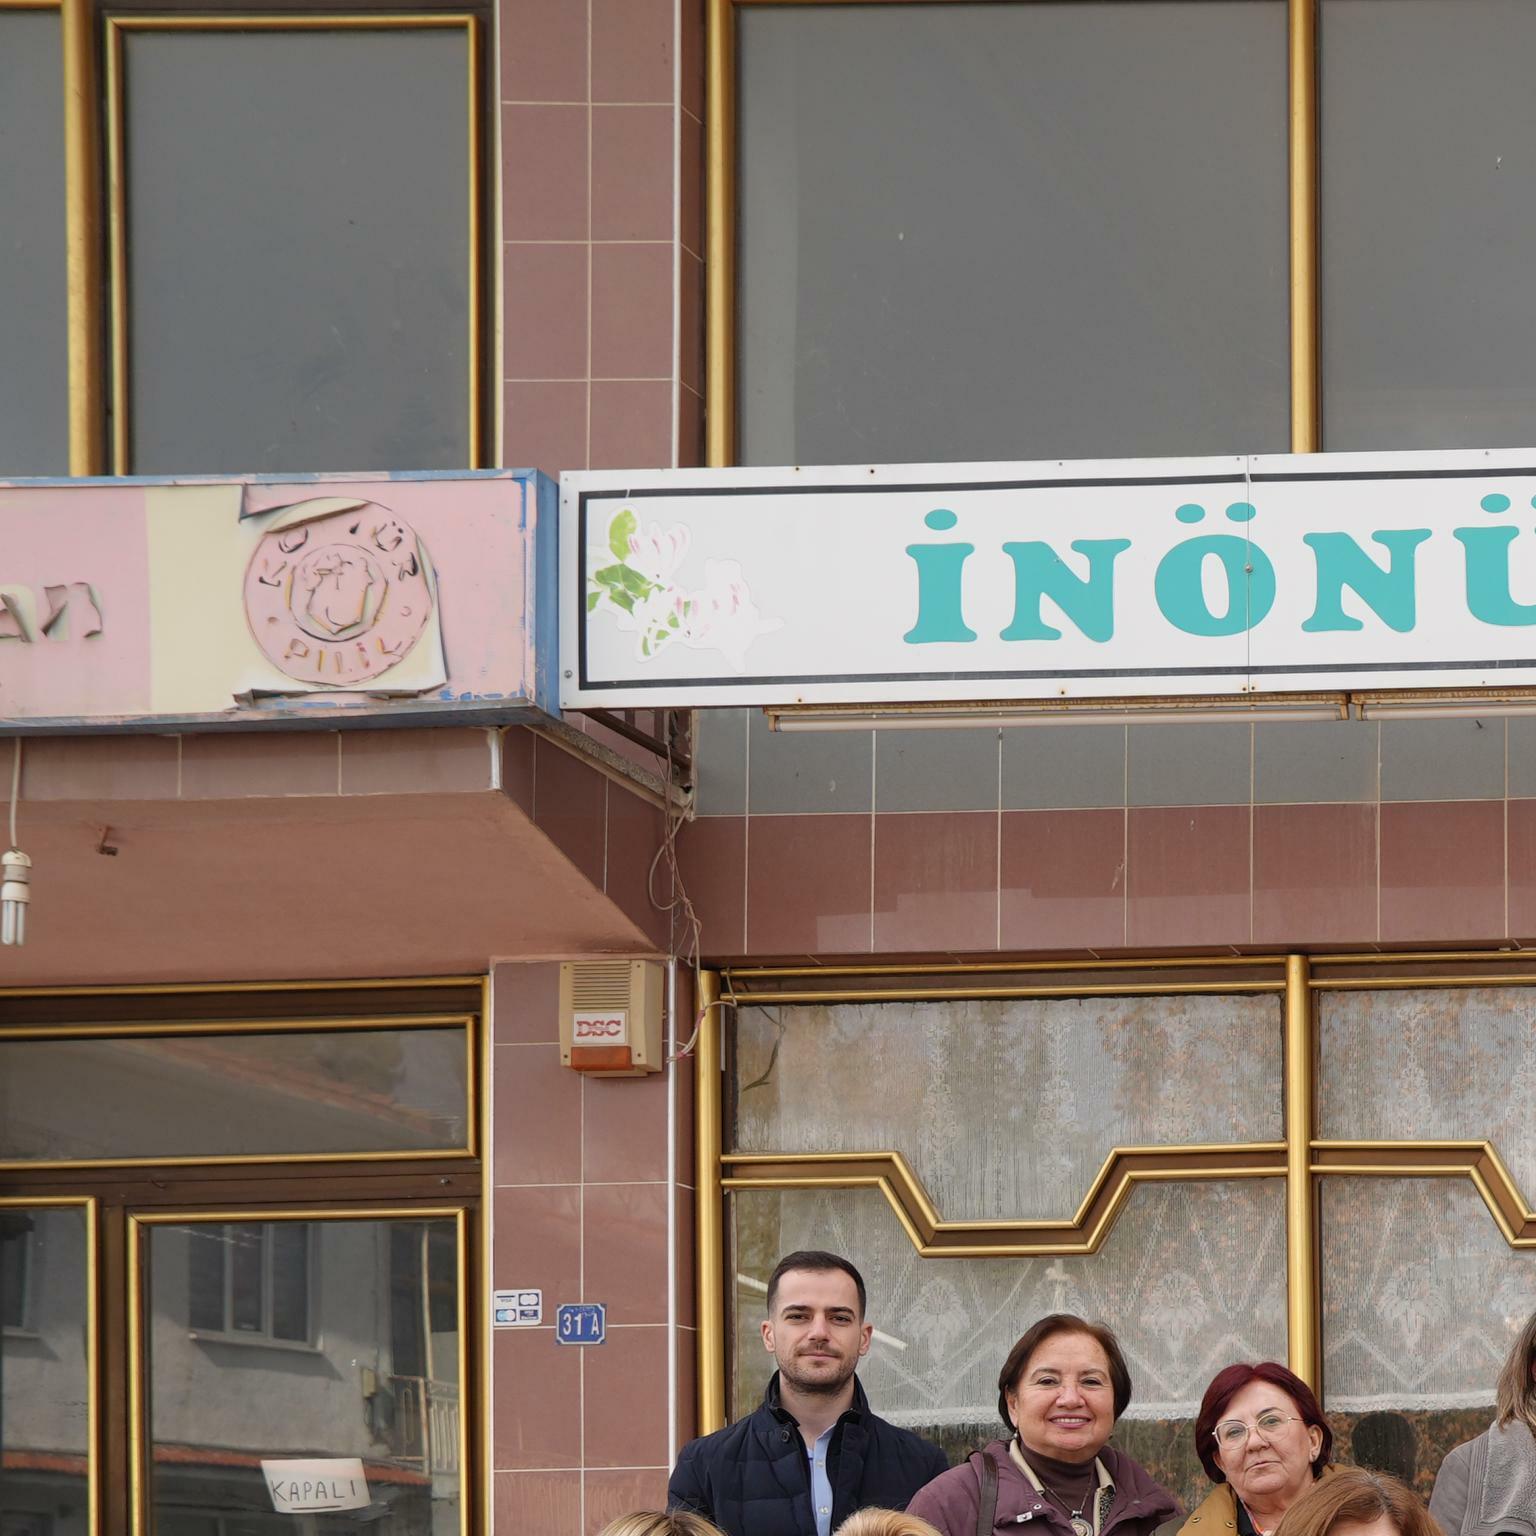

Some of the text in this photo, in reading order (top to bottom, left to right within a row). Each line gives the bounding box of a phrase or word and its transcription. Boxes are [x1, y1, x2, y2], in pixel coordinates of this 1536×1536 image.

[576, 1020, 621, 1037] DSC
[563, 1312, 600, 1336] 31 A
[271, 1480, 356, 1503] KAPALI
